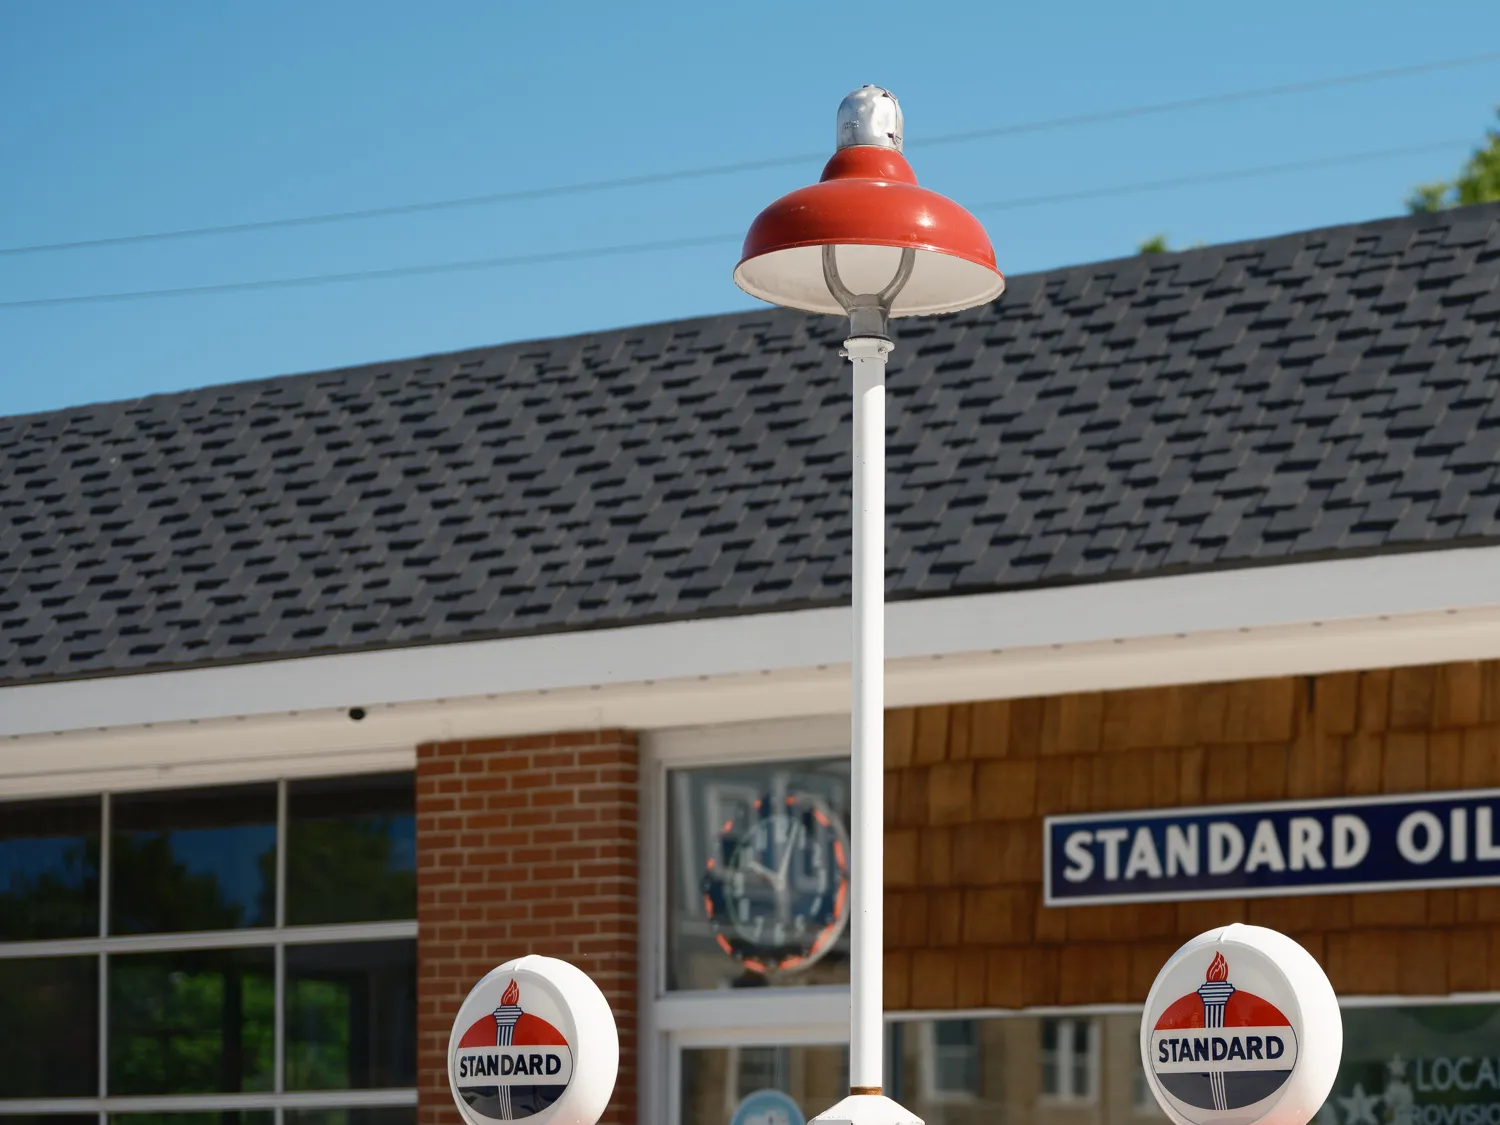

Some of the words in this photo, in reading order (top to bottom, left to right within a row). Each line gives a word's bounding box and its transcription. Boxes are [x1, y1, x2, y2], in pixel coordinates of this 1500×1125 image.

[1064, 815, 1370, 881] STANDARD
[1158, 1034, 1285, 1064] STANDARD
[459, 1053, 561, 1078] STANDARD
